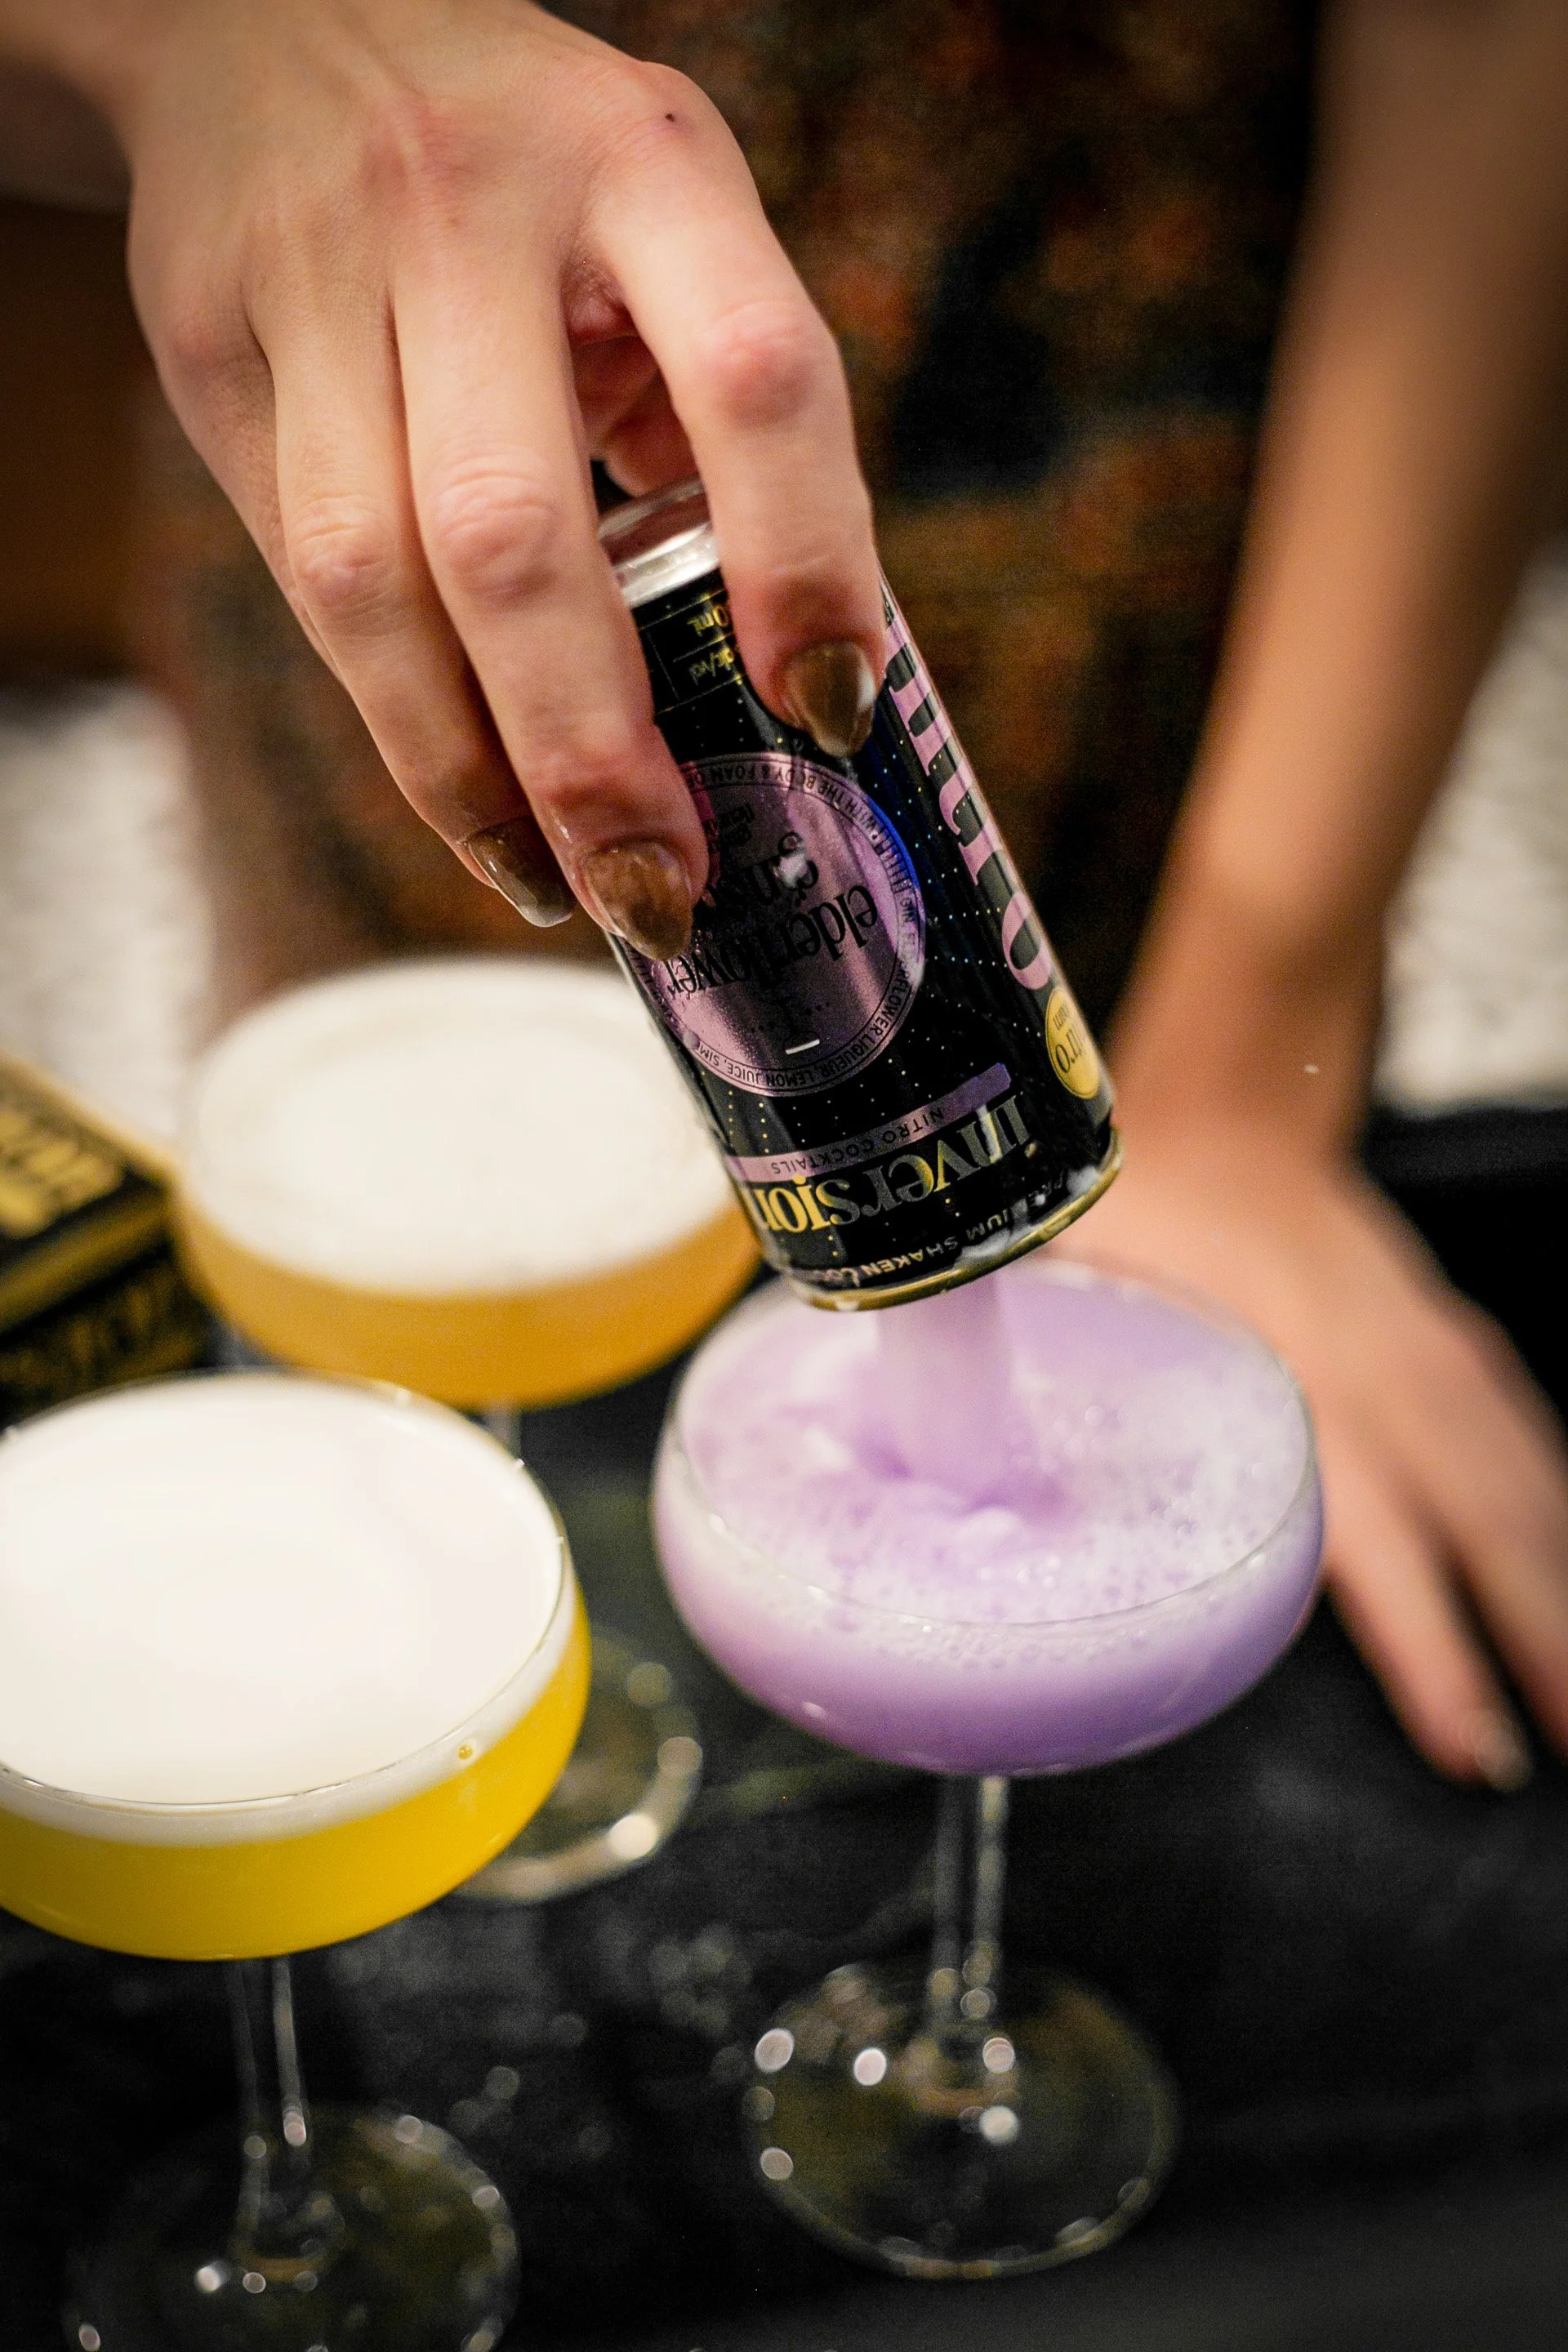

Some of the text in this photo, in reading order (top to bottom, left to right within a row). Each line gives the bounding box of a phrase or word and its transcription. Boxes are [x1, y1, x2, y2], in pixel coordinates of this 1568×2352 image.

[776, 768, 815, 788] BDY
[819, 782, 844, 807] THE
[664, 884, 879, 999] elderflower
[697, 1045, 718, 1064] SIM
[723, 1058, 760, 1083] JUICE,
[814, 1036, 872, 1078] LIQUEUR,
[767, 1069, 814, 1088] LEMON
[768, 1107, 944, 1176] NITRO COCKTAILS
[746, 1095, 1039, 1233] inversion
[860, 1236, 959, 1276] SHAKEN
